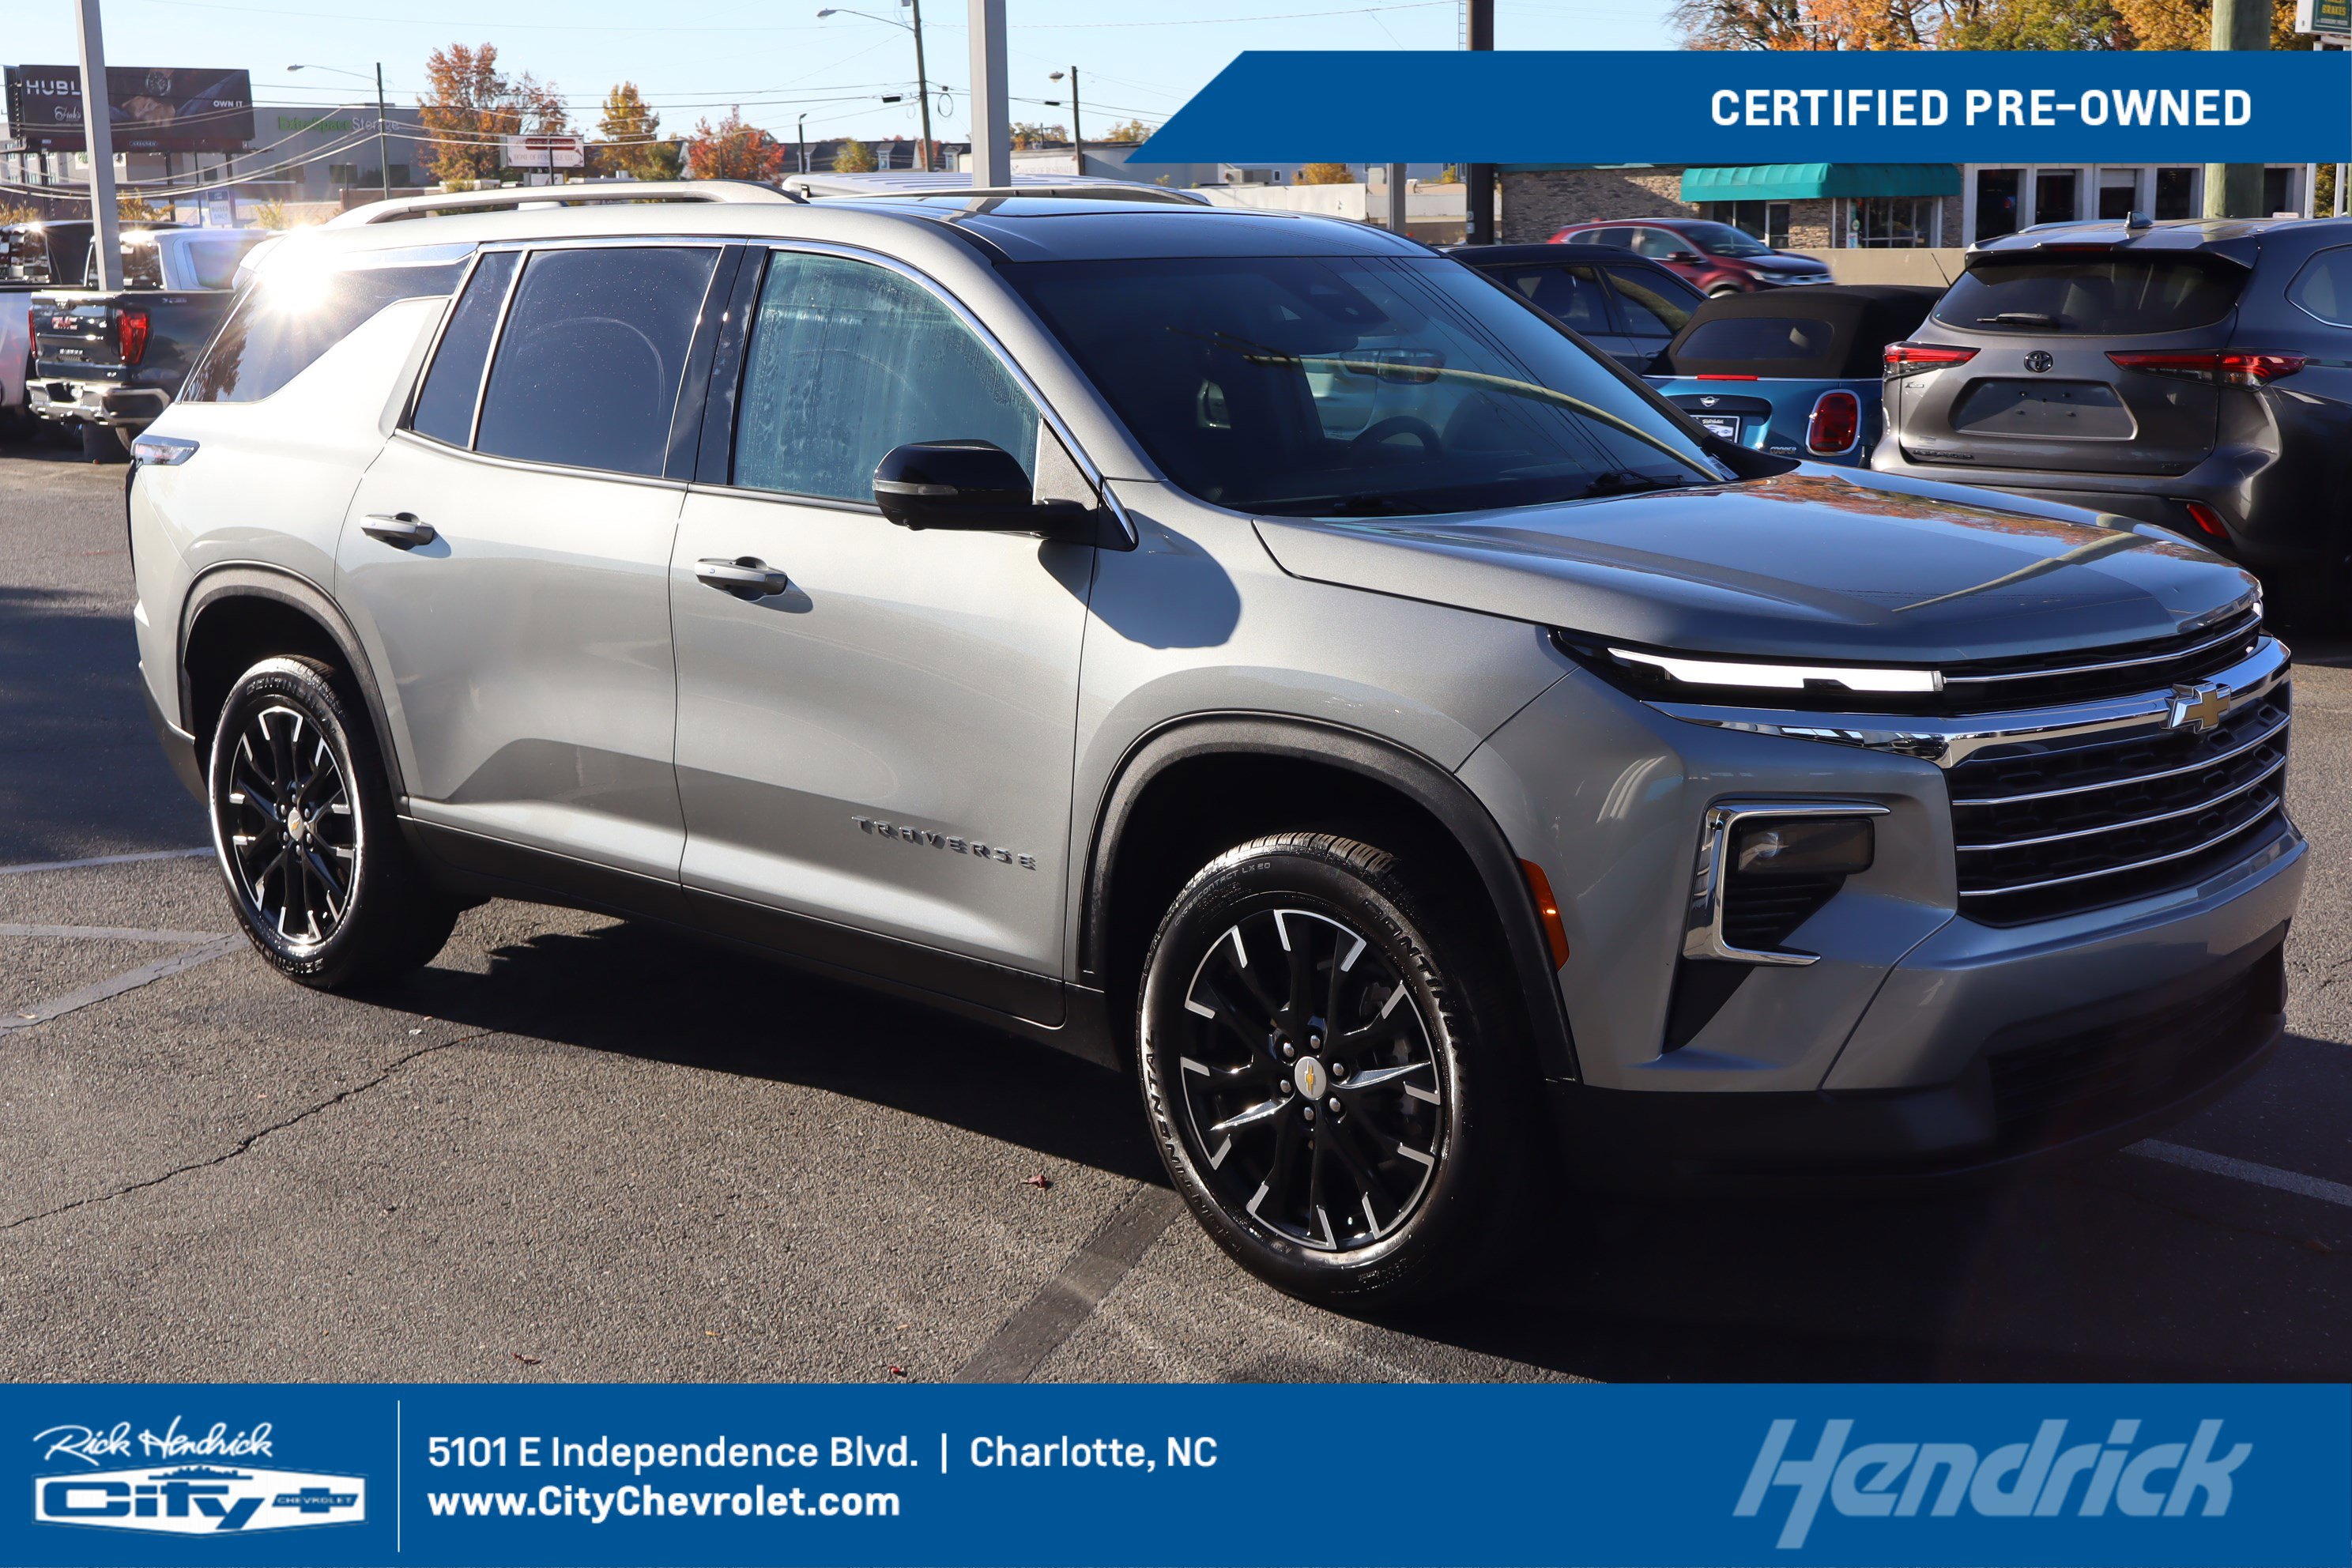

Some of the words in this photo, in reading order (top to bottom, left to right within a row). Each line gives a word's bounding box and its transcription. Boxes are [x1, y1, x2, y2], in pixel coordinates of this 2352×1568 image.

[26, 80, 81, 96] HUBL
[851, 815, 1038, 870] TRAVERSE
[1242, 865, 1256, 874] LX
